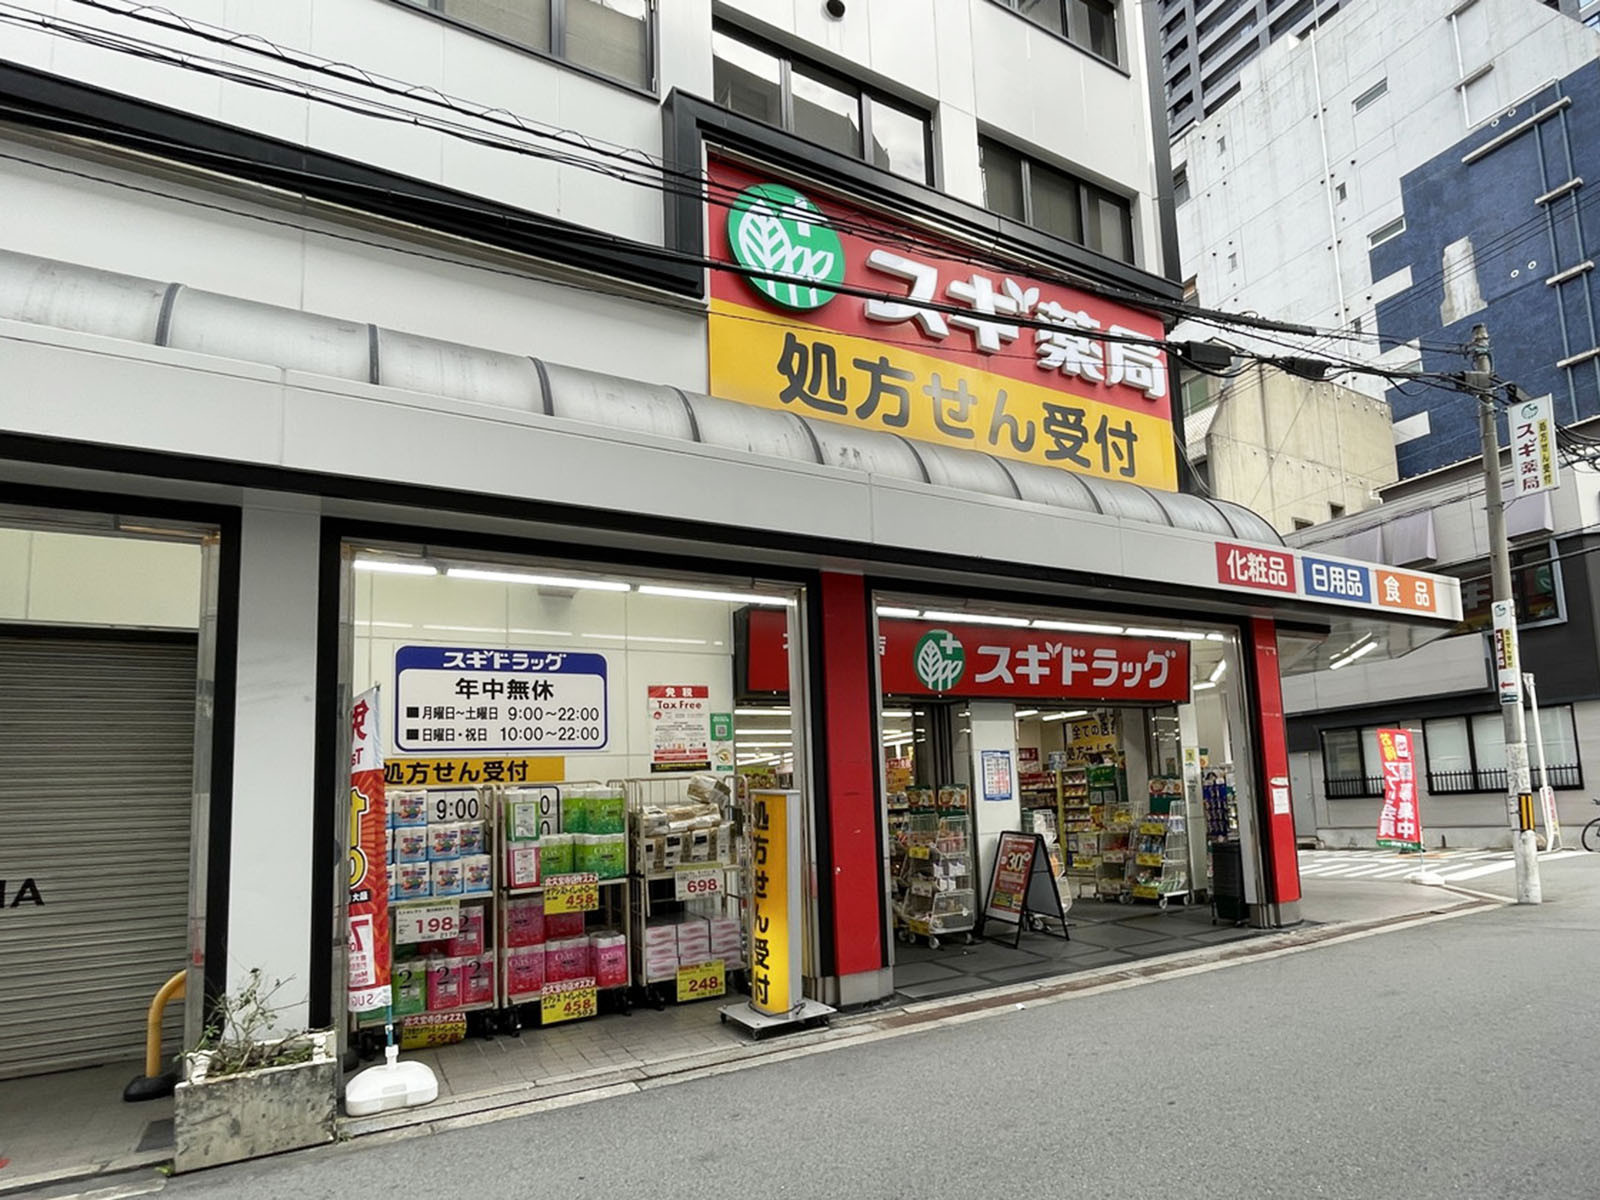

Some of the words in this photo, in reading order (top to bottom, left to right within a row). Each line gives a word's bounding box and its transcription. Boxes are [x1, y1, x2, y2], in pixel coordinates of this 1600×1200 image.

[865, 248, 1168, 399] スギ薬局
[776, 332, 1138, 478] 処方せん受付
[1226, 548, 1288, 587] 化粧品
[1311, 563, 1364, 597] 日用品
[1383, 575, 1430, 607] 食品
[443, 651, 567, 671] スギドラッグ
[974, 641, 1177, 689] スギドラッグ
[455, 677, 554, 701] 年中無休
[508, 706, 600, 722] 9:00～22:00
[656, 700, 677, 710] Tax
[679, 700, 702, 710] Free
[500, 726, 600, 742] 10:00～22:00
[384, 760, 529, 785] 処方せん受付
[436, 798, 479, 820] 9:00
[0, 878, 45, 908] A
[687, 878, 718, 893] 698
[565, 893, 594, 905] 458
[416, 916, 453, 934] 198
[398, 970, 412, 989] 2
[436, 967, 450, 986] 2
[688, 976, 718, 992] 248
[563, 998, 591, 1012] 458
